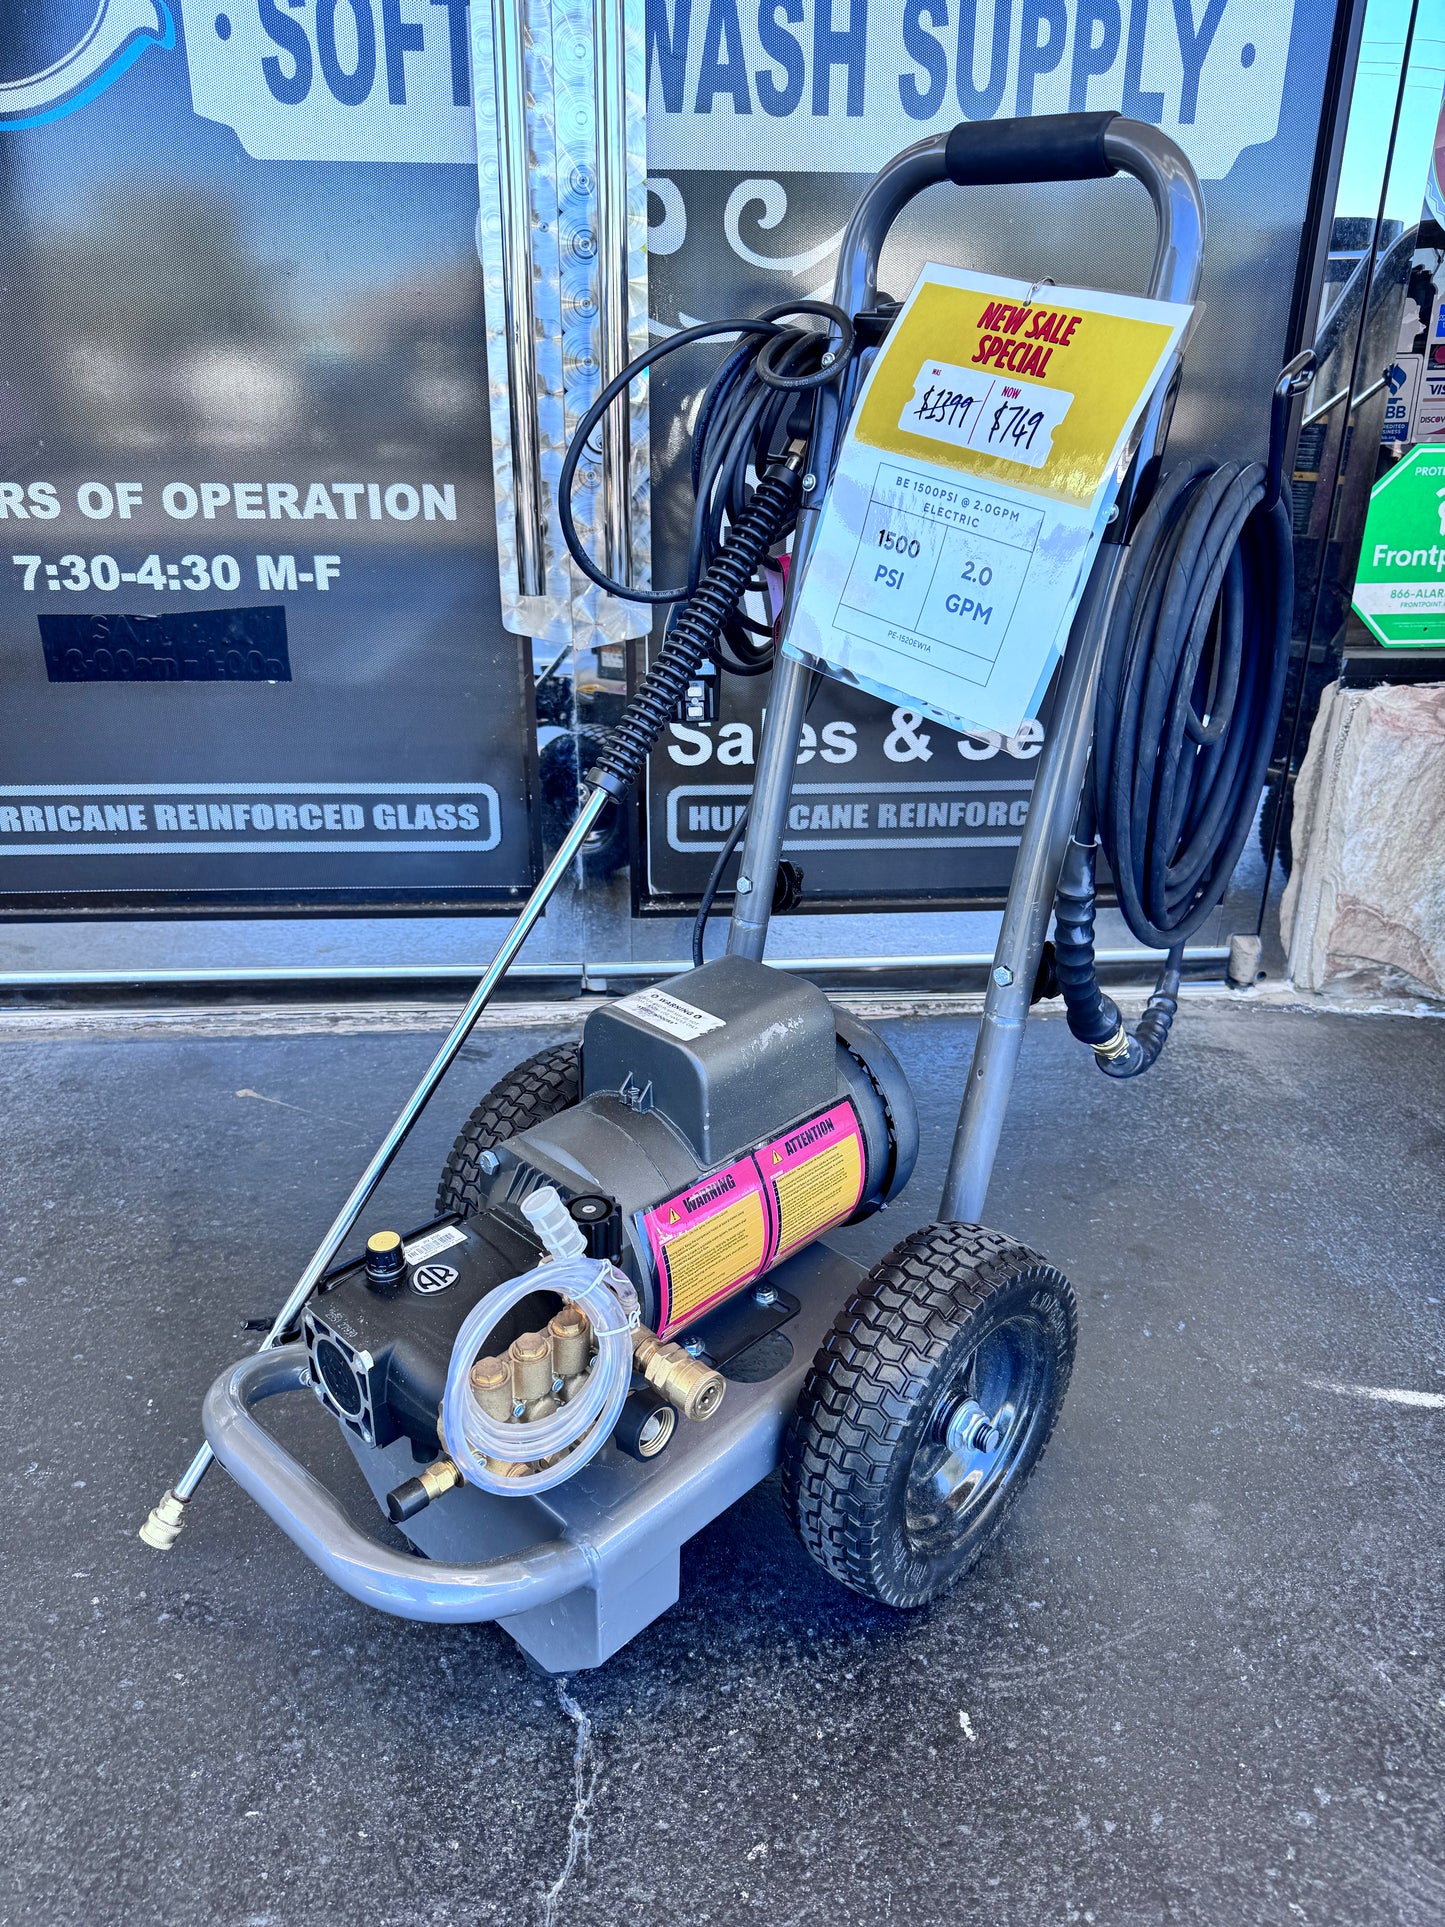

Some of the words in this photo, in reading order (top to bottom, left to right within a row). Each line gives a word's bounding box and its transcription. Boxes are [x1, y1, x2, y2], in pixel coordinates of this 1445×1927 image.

[261, 0, 471, 107] SOFT
[645, 0, 869, 117] WASH
[898, 0, 1229, 124] SUPPLY
[976, 302, 1032, 335] NEW
[1024, 311, 1082, 346] SALE
[971, 335, 1053, 378] SPECIAL
[1001, 386, 1022, 400] NOW
[988, 401, 1044, 450] $749
[0, 481, 61, 520] RS
[77, 481, 143, 519] OF
[162, 482, 457, 521] OPERATION
[896, 476, 910, 488] BE
[913, 481, 958, 504] 1500PSI
[961, 498, 970, 508] @
[973, 500, 1020, 522] 2.0GPM
[923, 502, 980, 528] ELECTRIC
[877, 528, 921, 559] 1500
[12, 554, 241, 592] 7:30-4:30
[257, 555, 341, 591] M-F
[874, 564, 905, 590] PSI
[961, 560, 993, 586] 2.0
[945, 593, 993, 625] GPM
[887, 629, 931, 653] PE-1520EW1A
[667, 708, 858, 766] Saes
[883, 707, 934, 763] &
[0, 804, 148, 832] RRICANE
[154, 803, 364, 832] REINFORCED
[373, 803, 480, 831] GLASS
[659, 997, 695, 1016] WARNING
[784, 1117, 835, 1156] ATTENTION
[682, 1173, 736, 1214] WARNING
